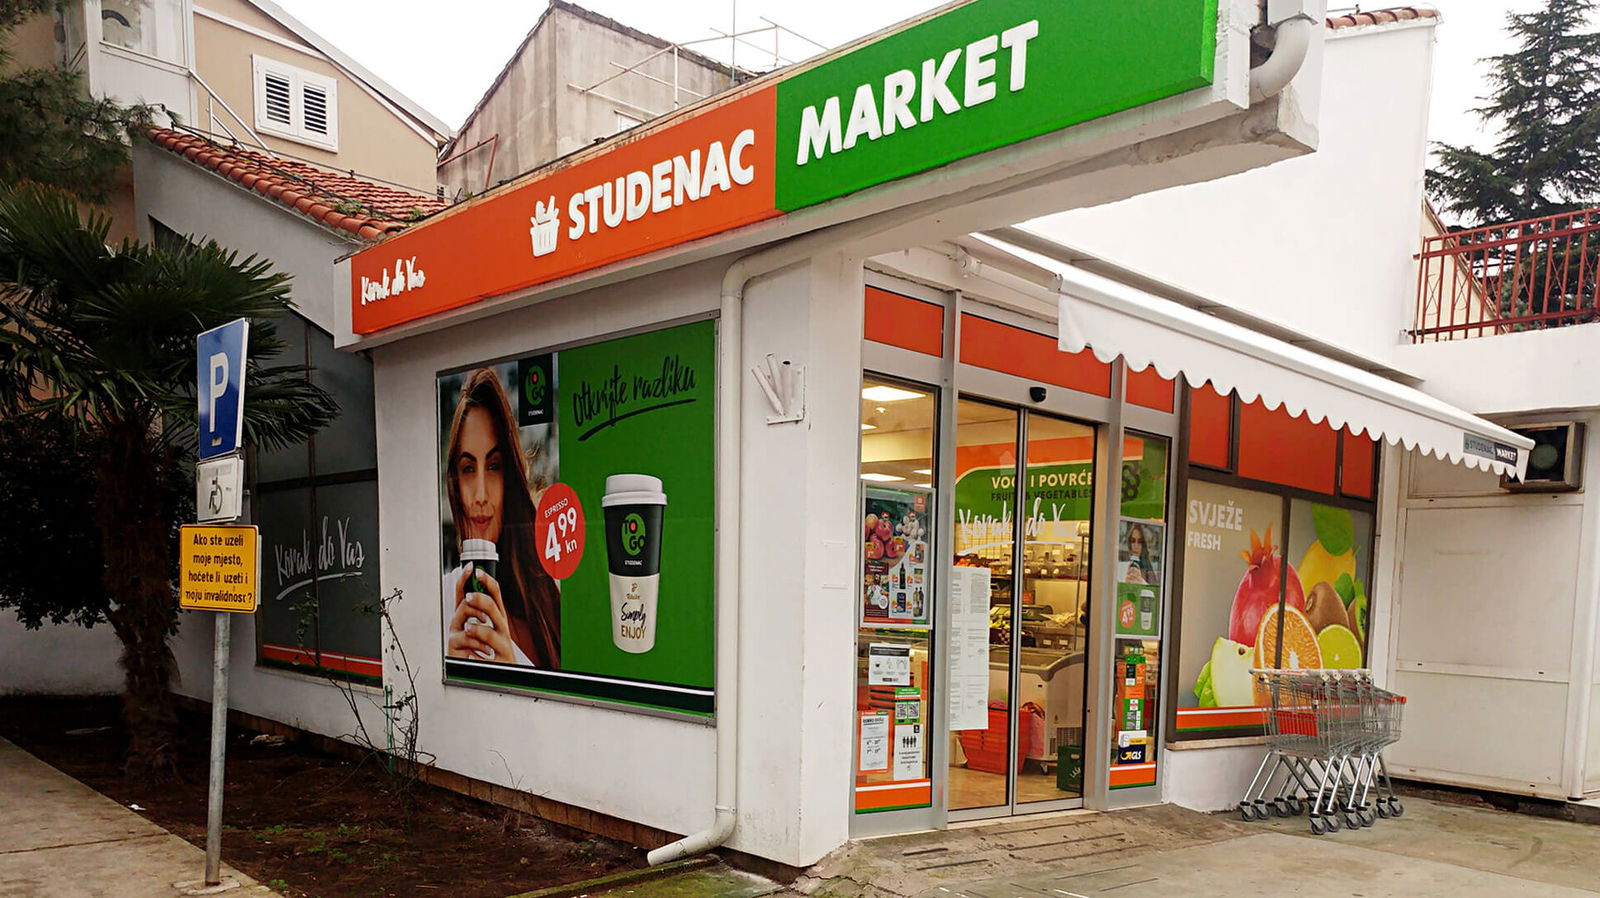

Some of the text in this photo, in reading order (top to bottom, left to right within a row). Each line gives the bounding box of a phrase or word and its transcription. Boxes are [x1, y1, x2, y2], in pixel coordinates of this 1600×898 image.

[797, 20, 1038, 165] MARKET
[568, 129, 754, 240] STUDENAC
[209, 352, 229, 432] P
[573, 355, 696, 427] Otkrijte razliku
[1496, 447, 1516, 462] MARKET
[1030, 475, 1035, 487] I
[544, 498, 568, 518] ESPRESSO
[1189, 500, 1243, 531] SVJEŽE
[622, 519, 638, 534] TO
[193, 534, 243, 546] Ako ste uzeli
[565, 539, 577, 554] kn
[629, 535, 645, 551] GO
[1187, 532, 1222, 550] FRESH
[275, 516, 365, 586] Korak do Vas
[193, 553, 243, 567] moje mjesto,
[216, 571, 220, 582] li
[224, 573, 243, 584] uzeti
[621, 602, 646, 628] Simply
[621, 624, 646, 639] ENJOY
